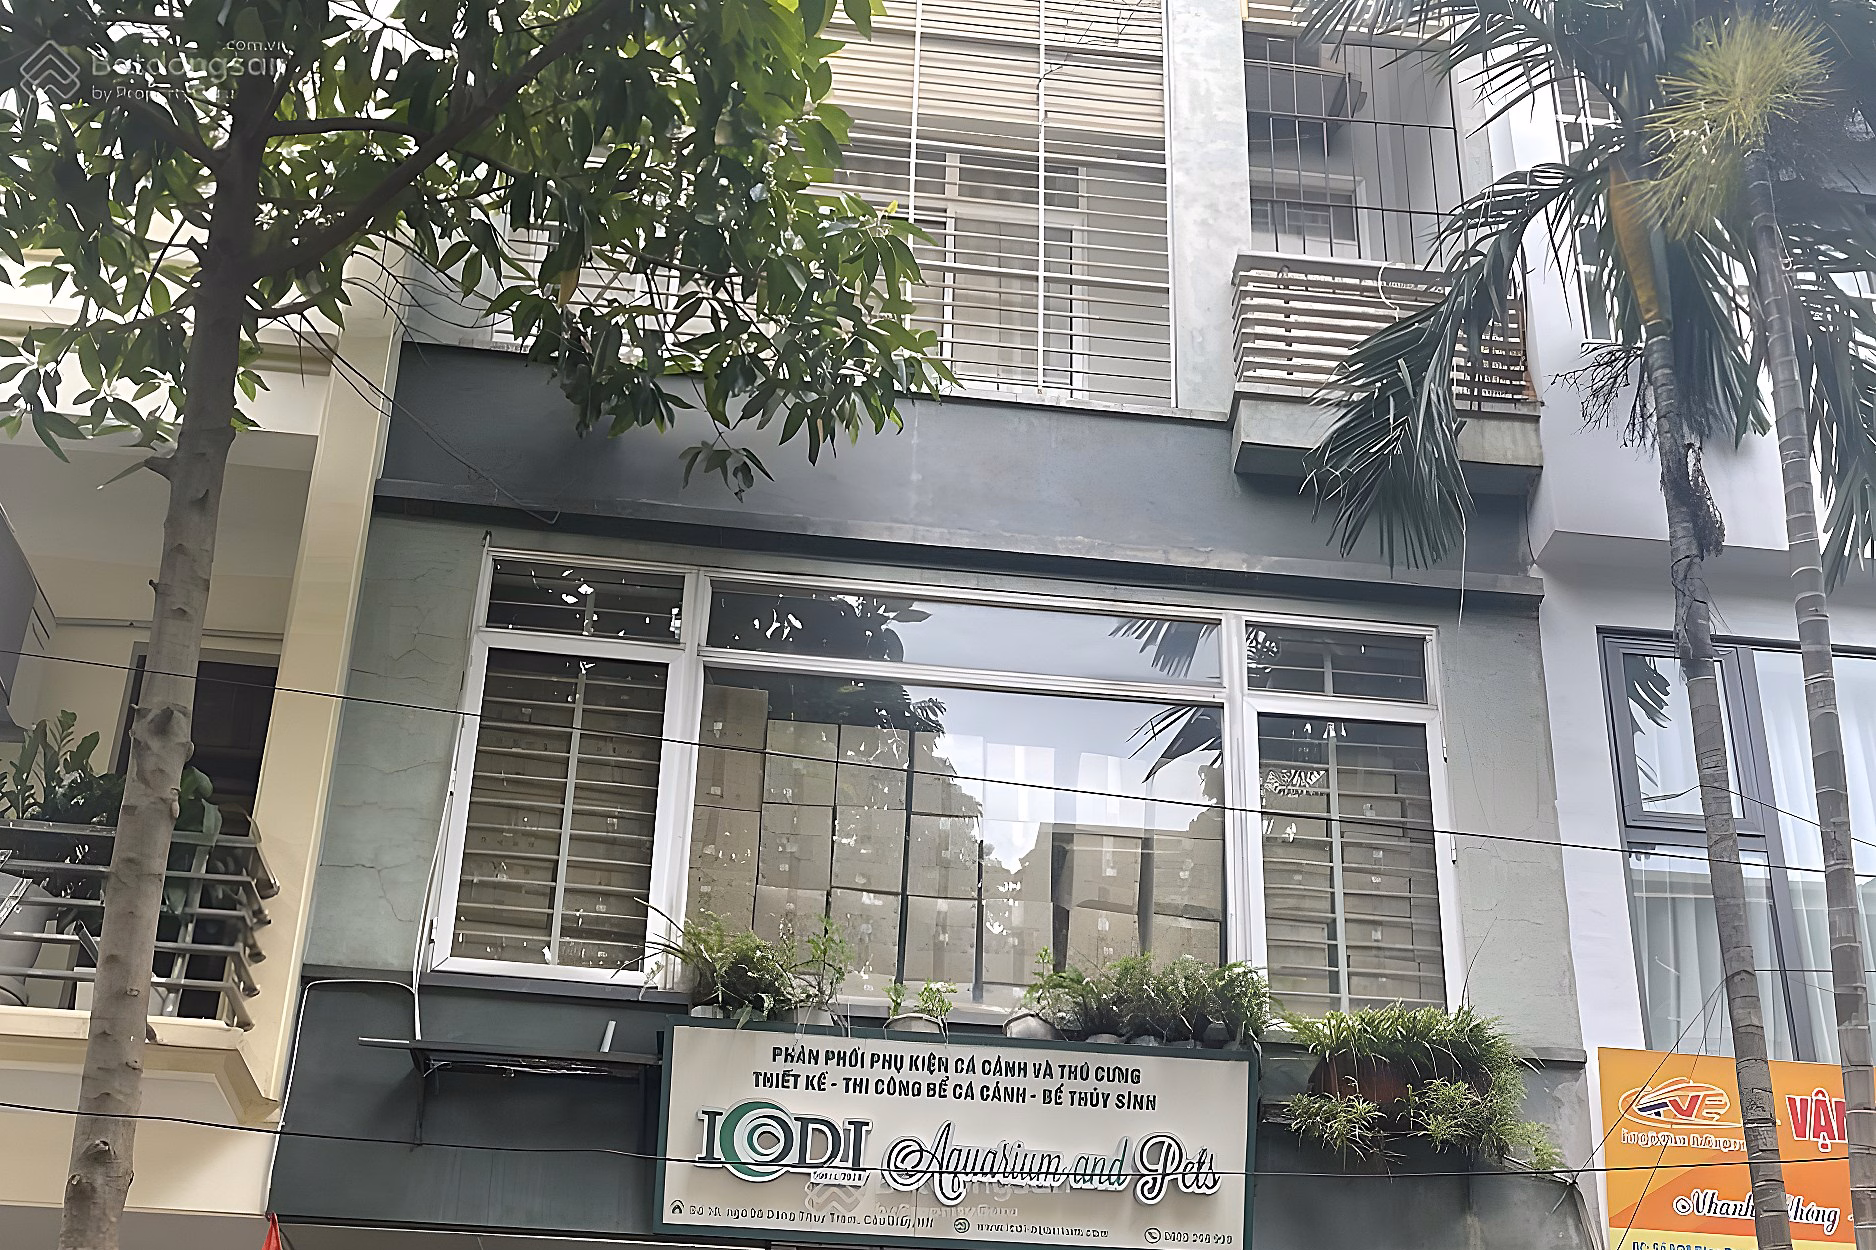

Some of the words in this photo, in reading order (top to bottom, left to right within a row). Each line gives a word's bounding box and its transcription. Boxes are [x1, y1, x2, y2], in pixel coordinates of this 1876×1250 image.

[870, 1052, 904, 1074] PHỤ
[909, 1052, 949, 1075] KIỆN
[843, 1077, 870, 1095] THI
[874, 1076, 922, 1098] CÔNG
[926, 1076, 950, 1099] BỂ
[1072, 1136, 1131, 1188] and
[1138, 1134, 1221, 1202] Pets
[1788, 1195, 1840, 1235] hóng
